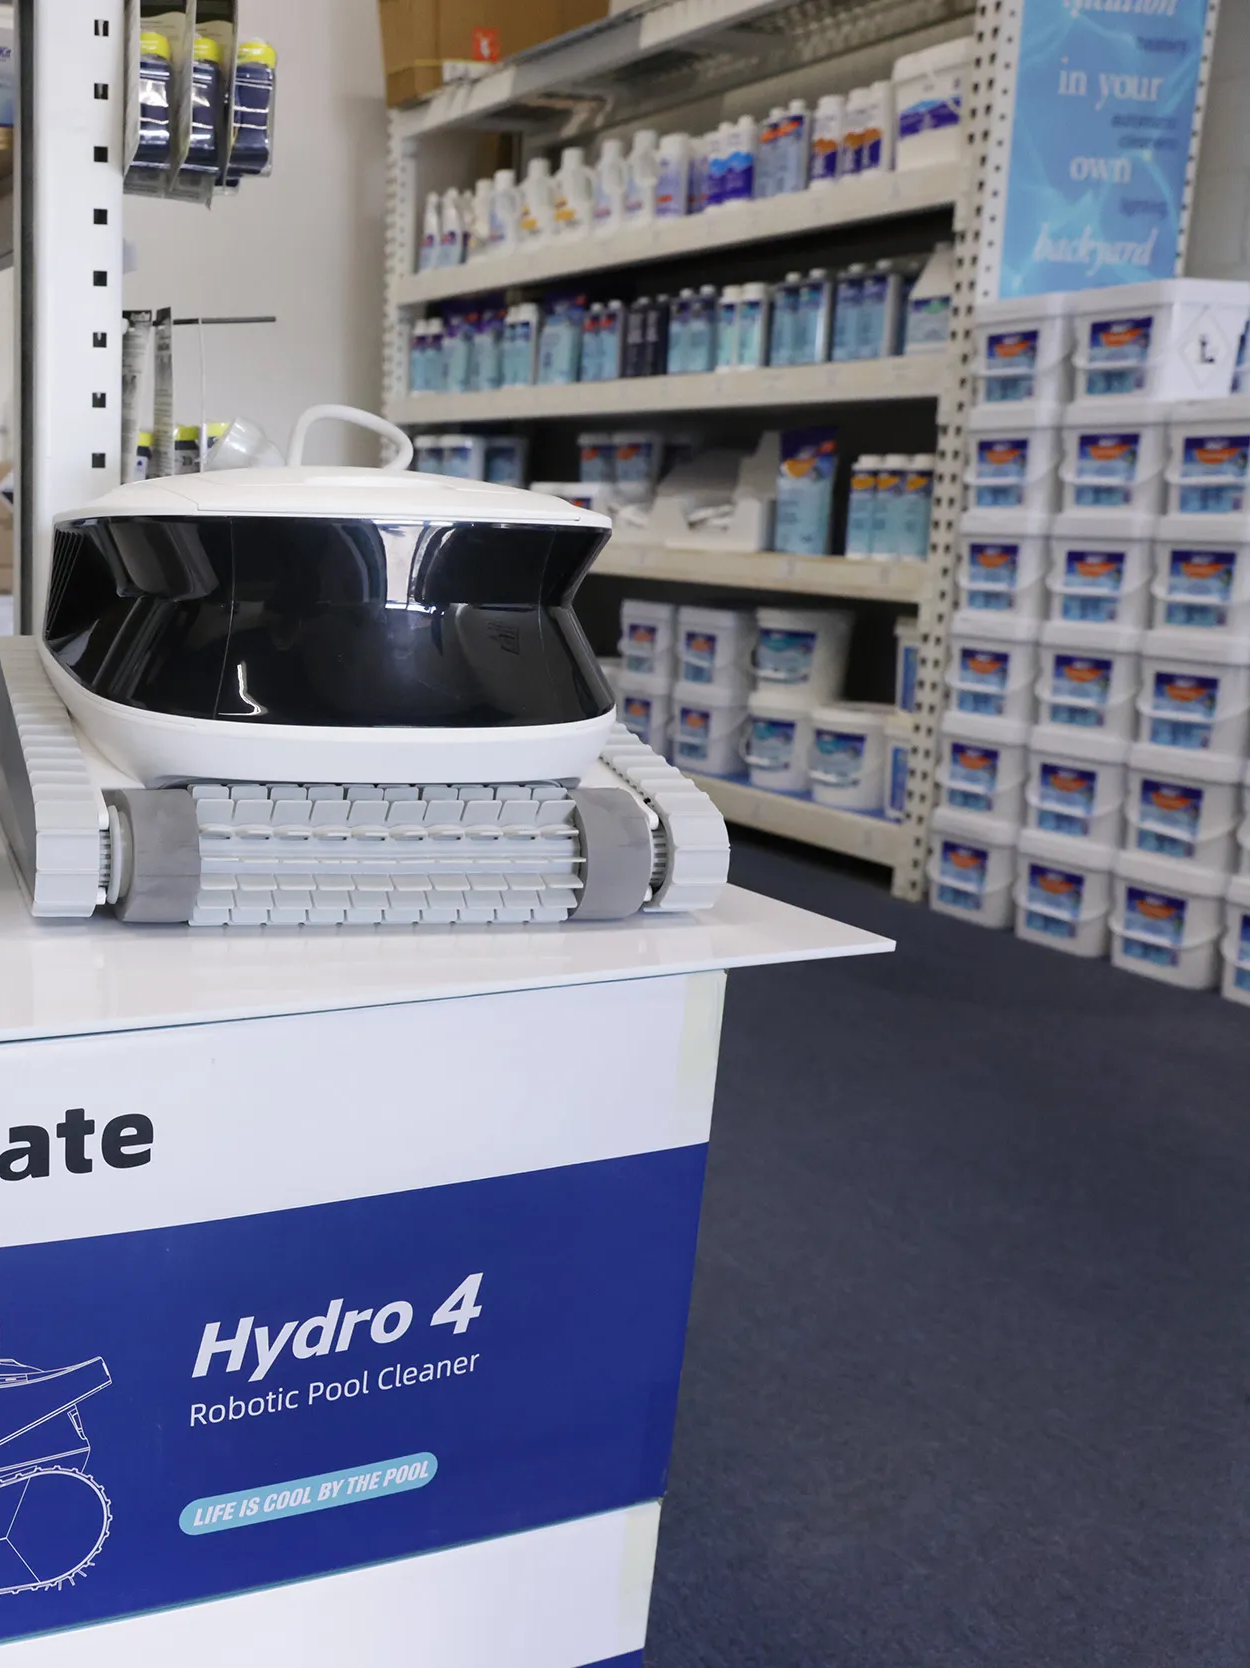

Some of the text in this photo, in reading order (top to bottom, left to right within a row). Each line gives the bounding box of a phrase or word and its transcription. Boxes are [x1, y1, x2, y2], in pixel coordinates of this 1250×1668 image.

[1058, 57, 1164, 111] in your
[1070, 154, 1132, 184] own
[1032, 222, 1160, 277] backyard
[191, 1272, 484, 1383] Hydro 4
[190, 1353, 480, 1427] Robotic Pool Cleaner
[193, 1459, 430, 1527] LIFE IS COOL BY THE POOL
